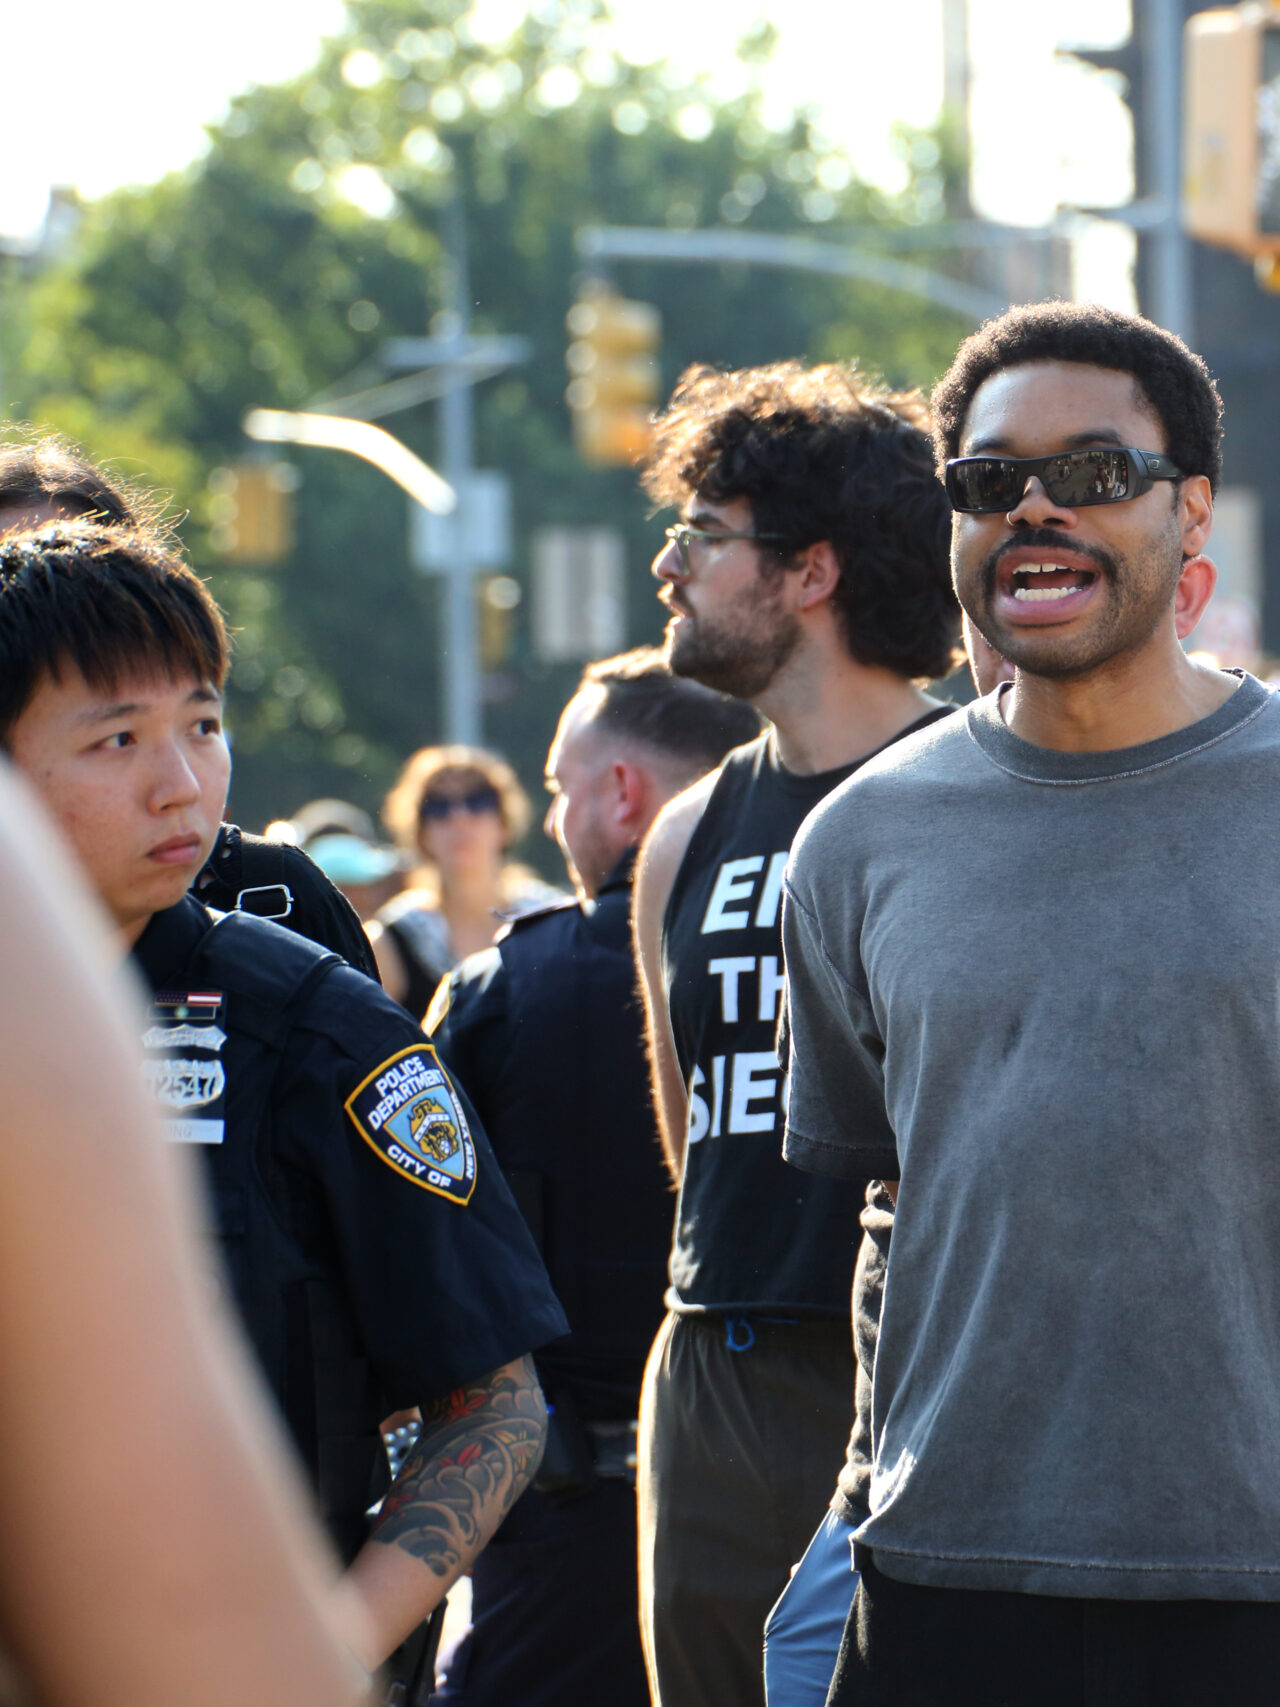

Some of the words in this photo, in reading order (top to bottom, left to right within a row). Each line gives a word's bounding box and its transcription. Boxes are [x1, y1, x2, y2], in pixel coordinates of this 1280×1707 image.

[368, 1069, 445, 1131] DEPARTMENT
[375, 1056, 425, 1097] POLICE
[689, 1051, 788, 1144] SIE
[387, 1144, 426, 1175] CITY
[427, 1170, 452, 1187] OF
